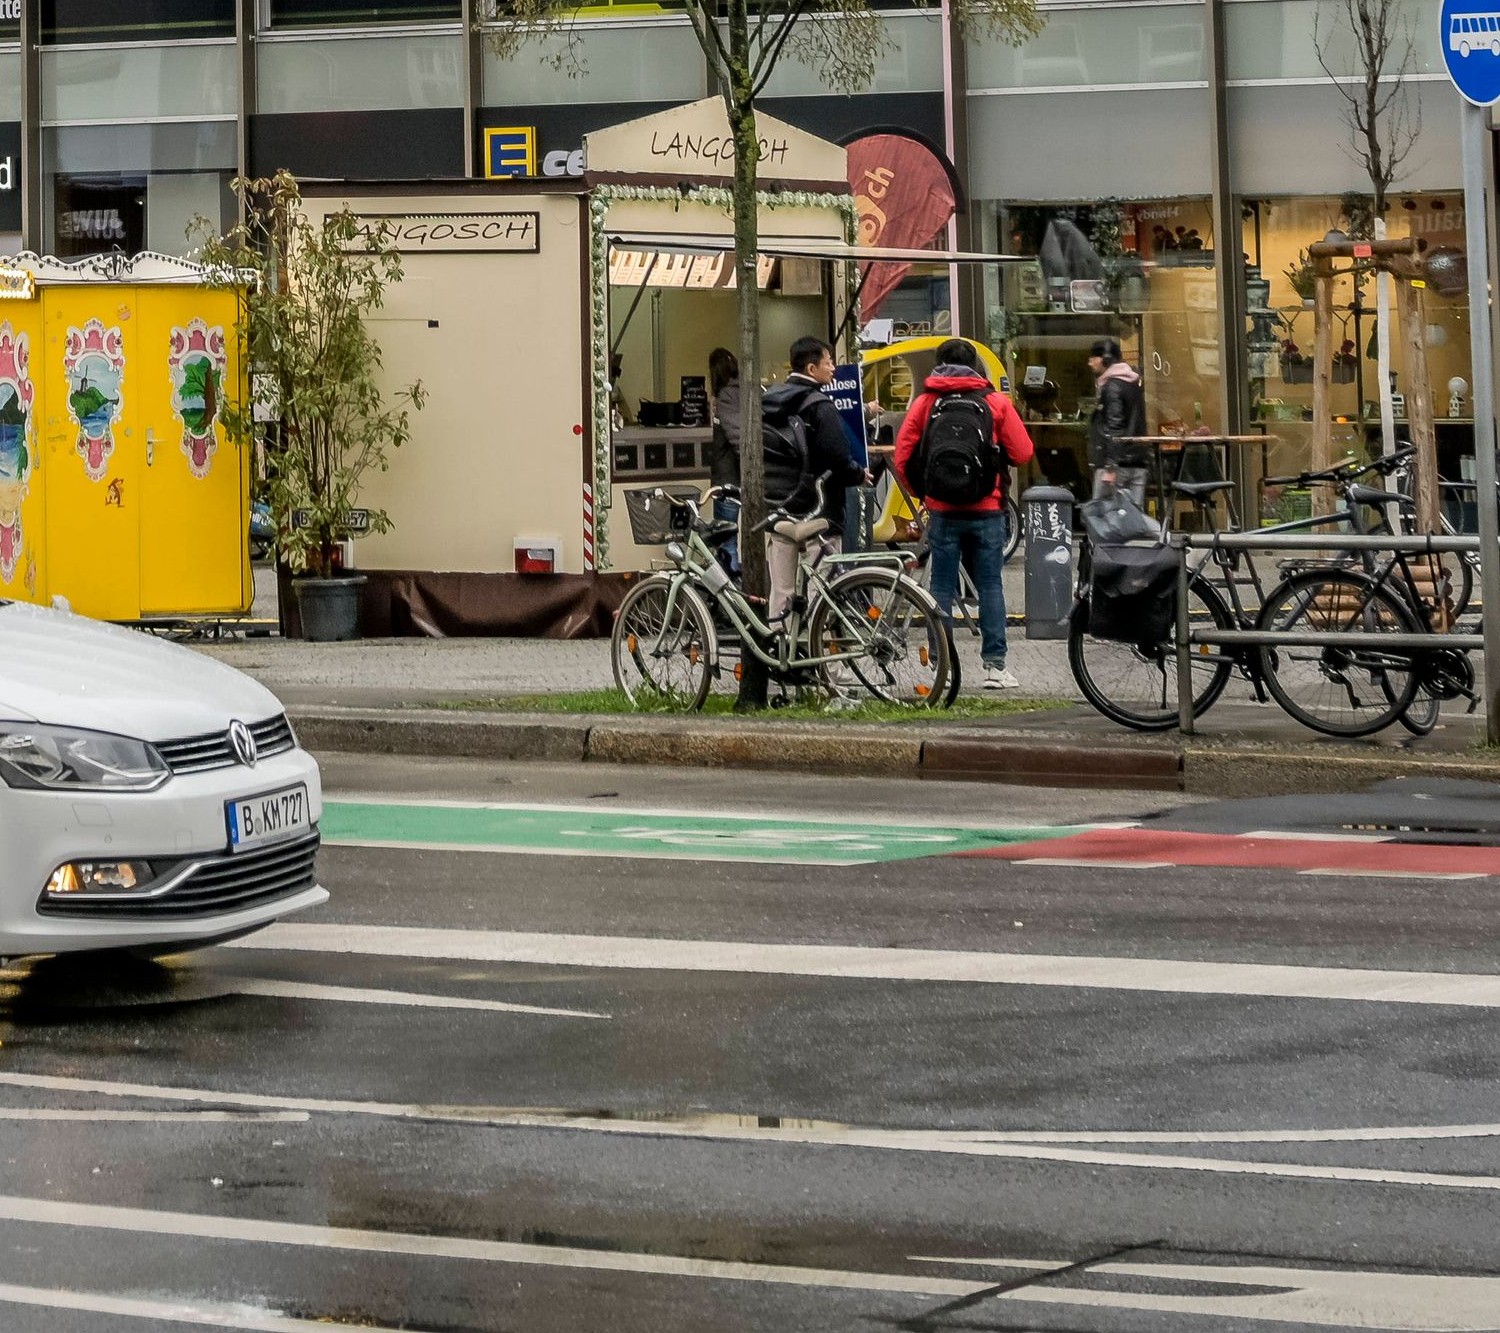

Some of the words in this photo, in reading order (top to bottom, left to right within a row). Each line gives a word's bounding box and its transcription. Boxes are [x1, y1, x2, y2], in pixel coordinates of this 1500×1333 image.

[651, 130, 789, 167] LANGOCH
[350, 221, 535, 245] ANGOSCH
[242, 805, 254, 837] B
[261, 797, 282, 833] KM
[281, 791, 303, 827] 727
